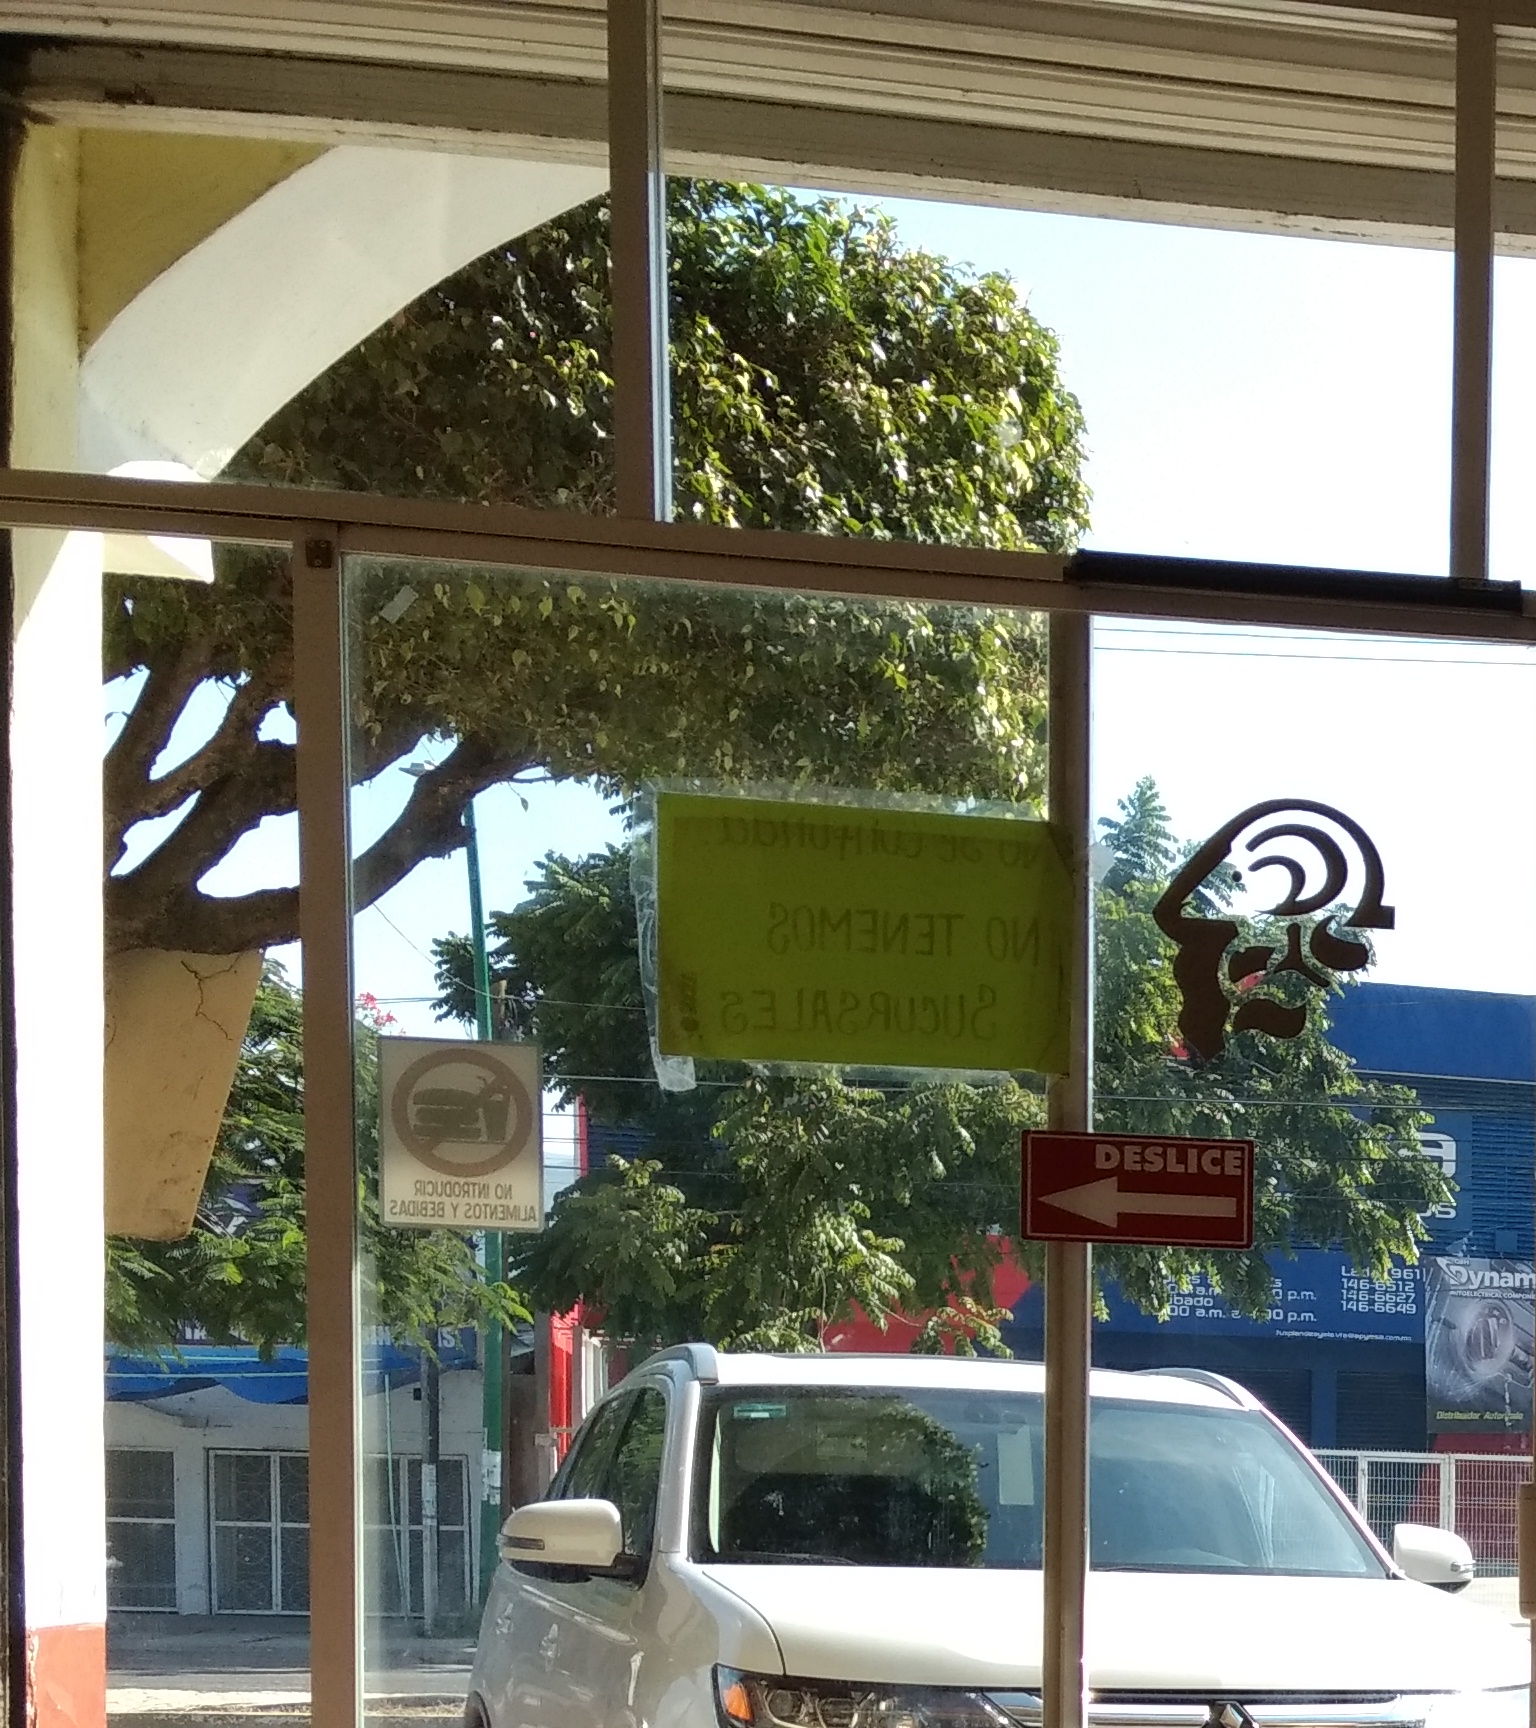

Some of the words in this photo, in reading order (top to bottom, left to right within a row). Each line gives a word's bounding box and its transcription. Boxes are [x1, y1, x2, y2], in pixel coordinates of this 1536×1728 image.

[1095, 1143, 1242, 1176] DESLICE
[1449, 1264, 1536, 1290] Dynam
[1341, 1289, 1416, 1303] 146-6627
[1341, 1300, 1417, 1315] 146-6649
